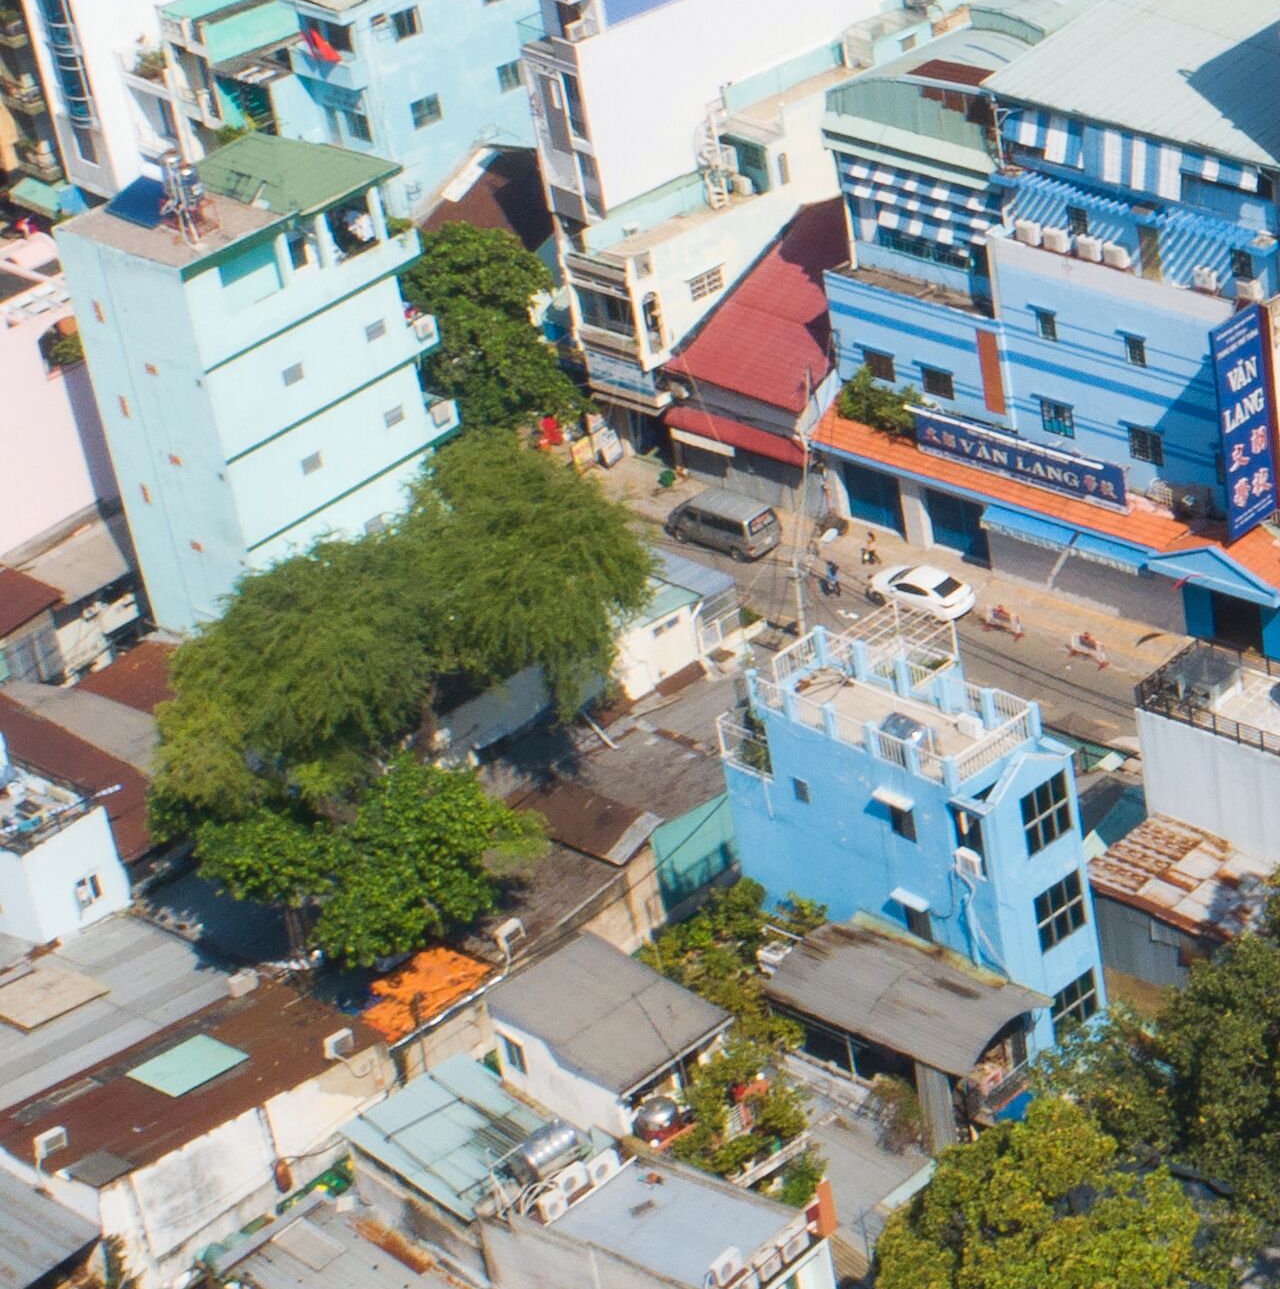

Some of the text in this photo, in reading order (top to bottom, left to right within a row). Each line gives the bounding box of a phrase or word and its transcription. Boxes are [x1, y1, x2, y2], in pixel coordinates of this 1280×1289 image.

[1227, 355, 1258, 393] VĂN
[1223, 387, 1264, 434] LANG
[959, 439, 1009, 466] VĂN
[1016, 456, 1079, 488] LANG
